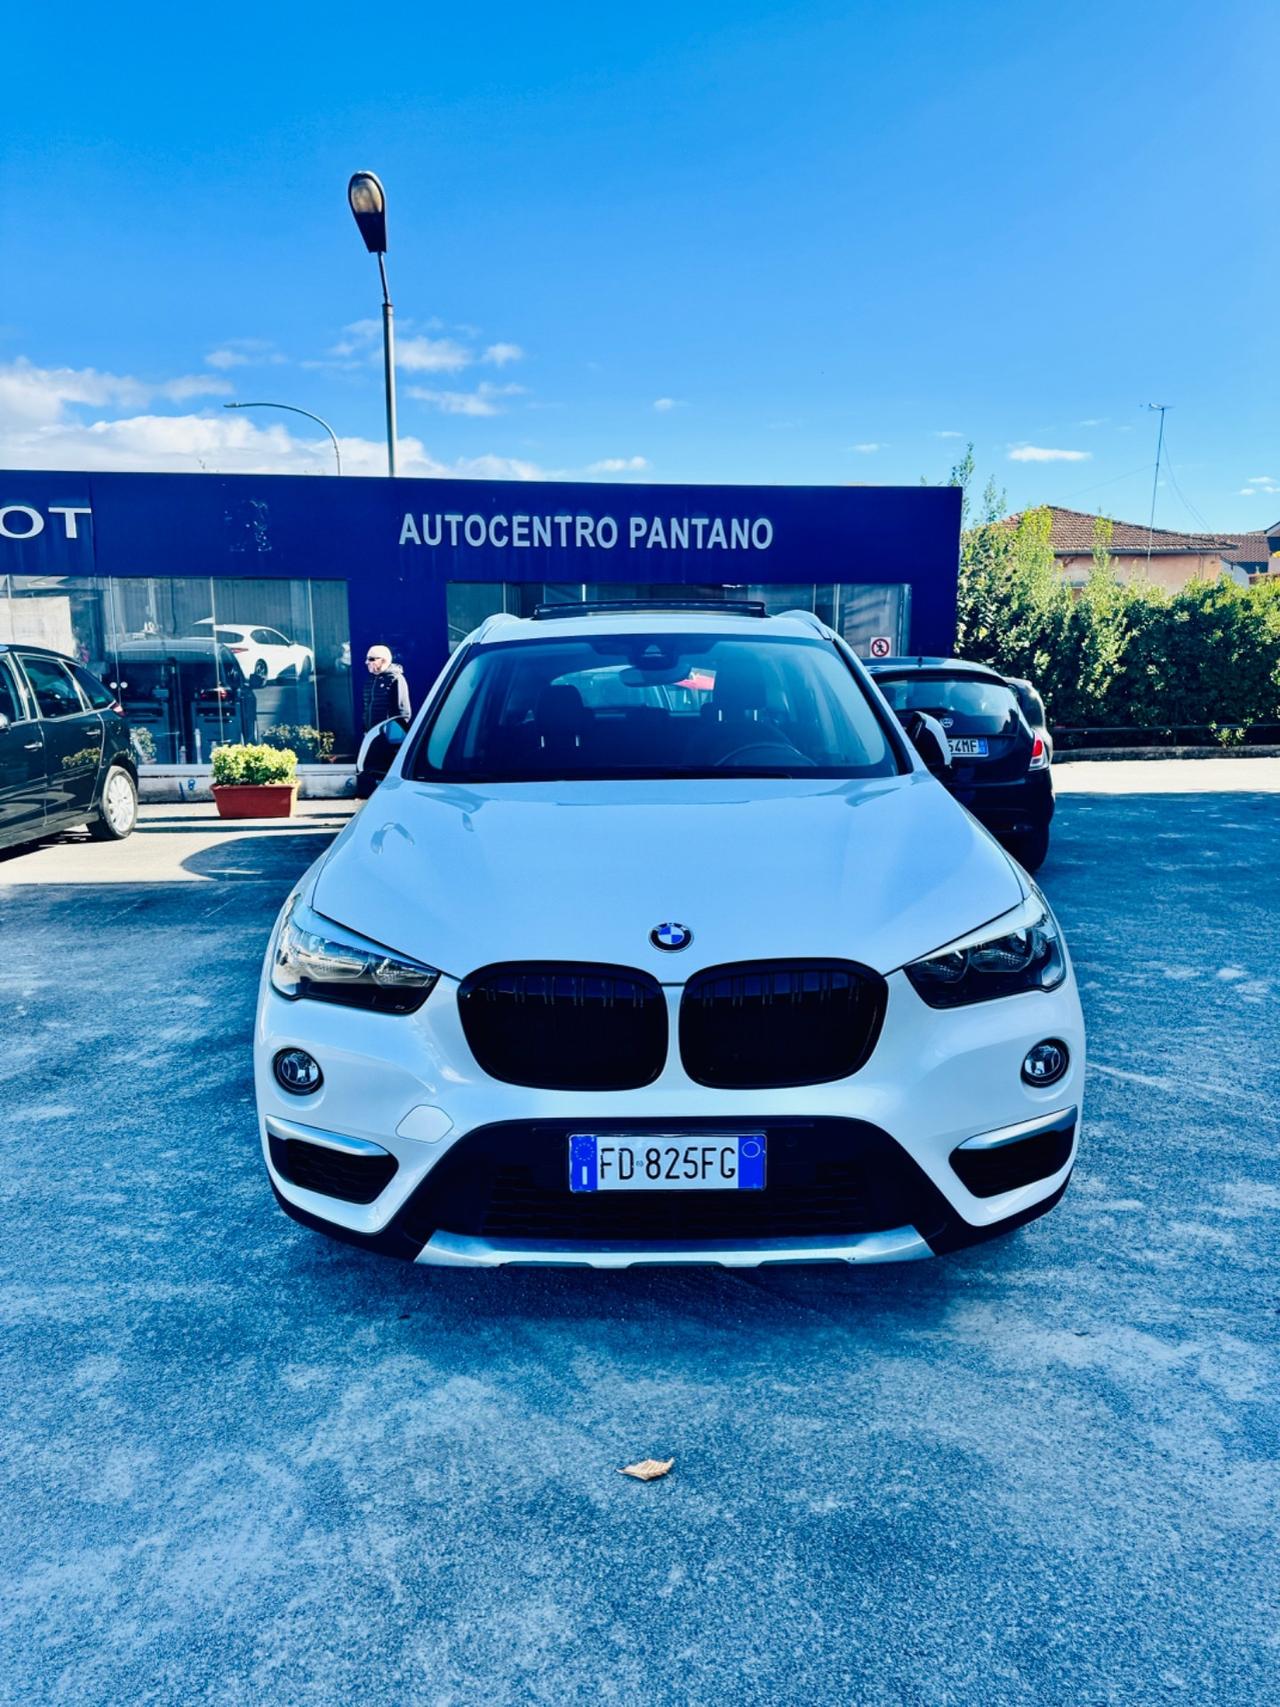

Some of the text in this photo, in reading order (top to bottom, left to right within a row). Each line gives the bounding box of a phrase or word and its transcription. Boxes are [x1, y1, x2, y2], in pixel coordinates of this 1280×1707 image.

[399, 513, 774, 550] AUTOCENTRO PANTANO
[600, 1147, 634, 1180] FD
[645, 1147, 736, 1180] 825FG
